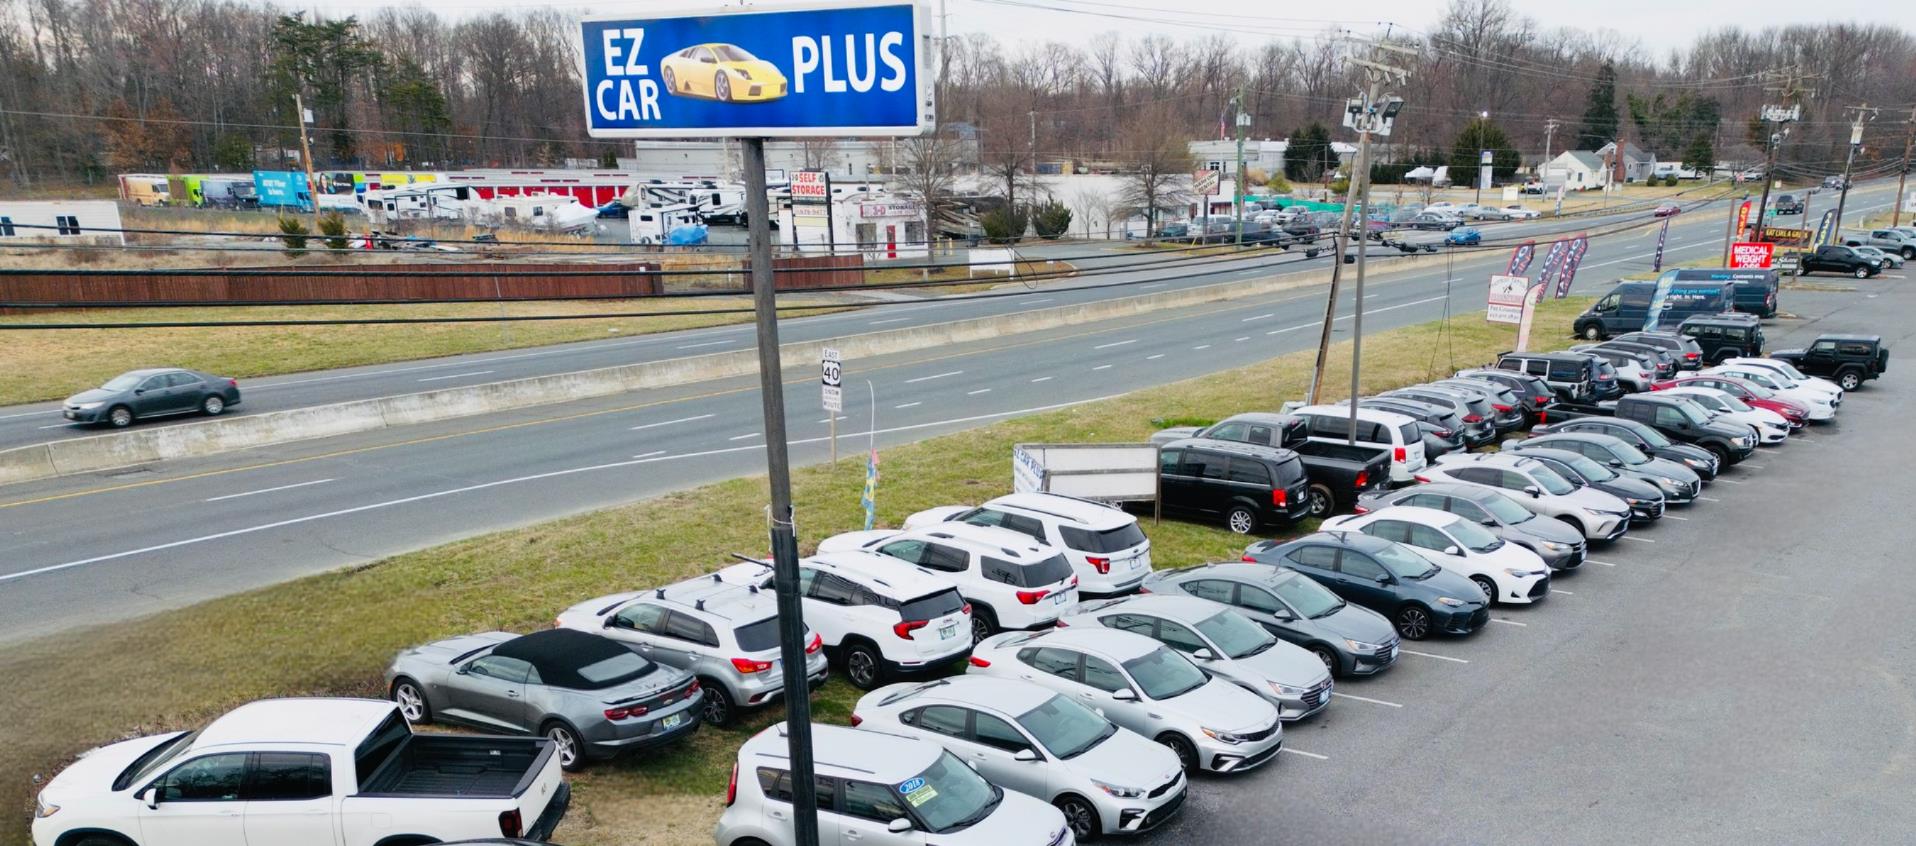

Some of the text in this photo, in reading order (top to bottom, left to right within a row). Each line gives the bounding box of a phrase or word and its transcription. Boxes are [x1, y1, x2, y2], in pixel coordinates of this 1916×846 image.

[602, 28, 649, 77] EZ
[792, 31, 906, 94] PLUS
[596, 79, 662, 121] CAR
[799, 173, 817, 183] SELF
[792, 185, 825, 195] STORAGE
[1734, 245, 1769, 255] MEDICAL
[1735, 254, 1767, 263] WEIGHT
[824, 349, 838, 359] EAST
[824, 367, 839, 381] 40
[905, 778, 921, 792] 2018
